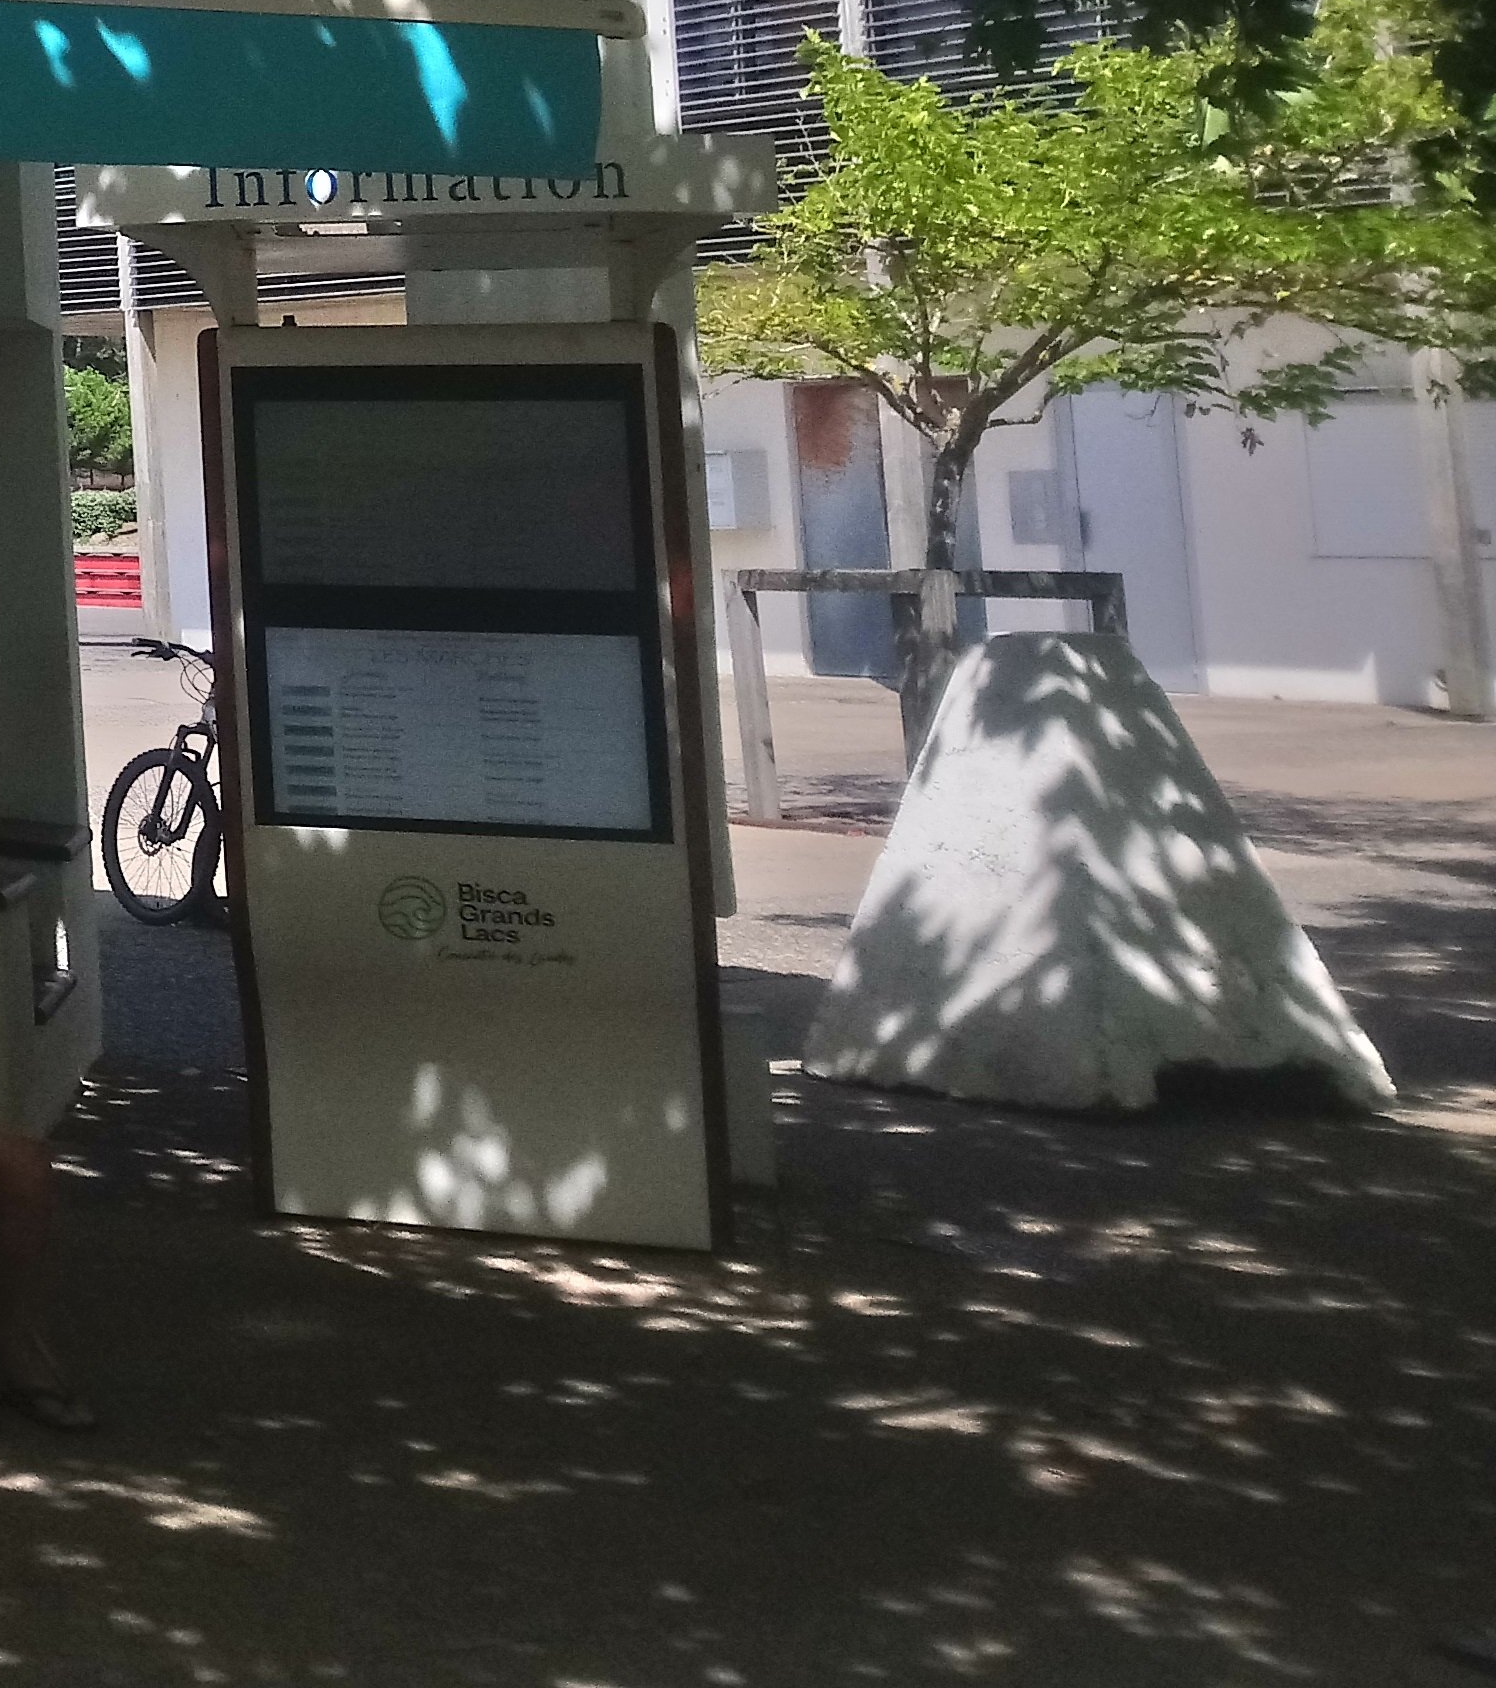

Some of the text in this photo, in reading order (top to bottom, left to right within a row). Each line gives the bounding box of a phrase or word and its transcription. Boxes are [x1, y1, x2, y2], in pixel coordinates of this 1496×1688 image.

[457, 882, 528, 905] Bisca
[460, 904, 556, 927] Grands
[461, 923, 521, 944] Lacs
